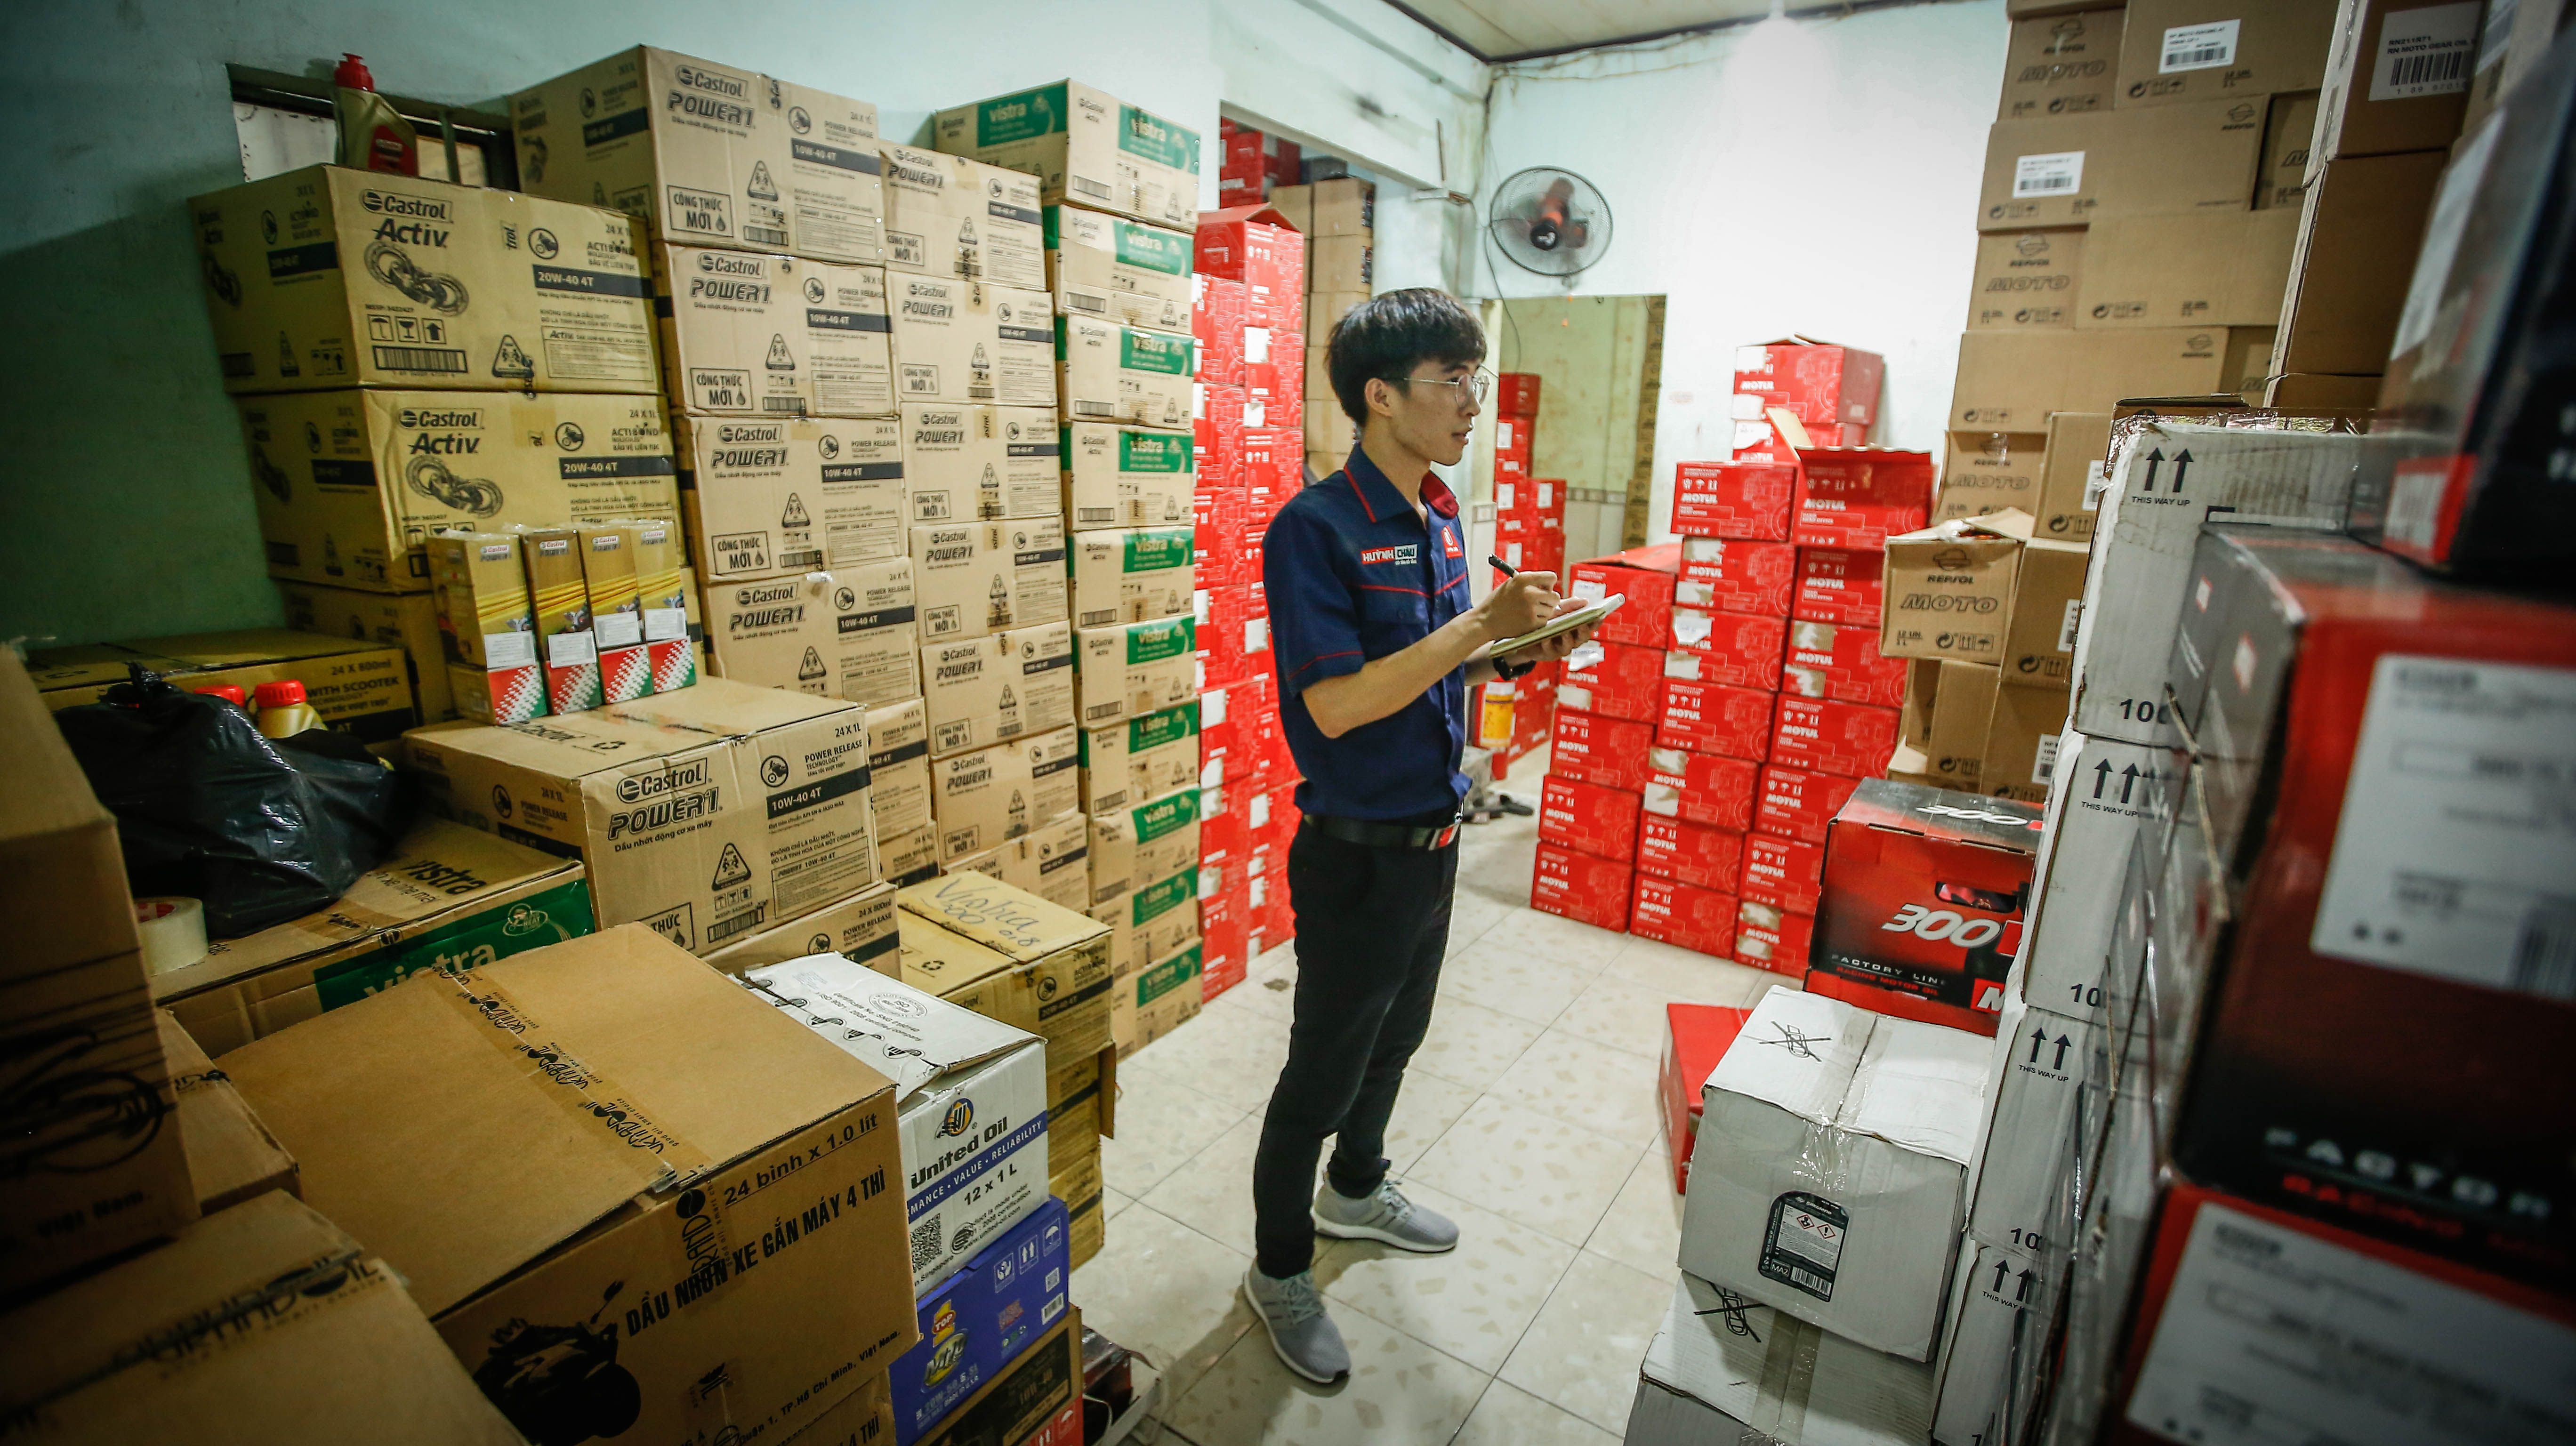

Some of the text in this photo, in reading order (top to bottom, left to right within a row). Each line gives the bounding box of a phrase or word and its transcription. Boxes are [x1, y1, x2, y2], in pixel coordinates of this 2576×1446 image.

[695, 72, 742, 96] Castrol
[667, 89, 755, 128] POWER1
[990, 103, 1026, 121] vistra
[385, 195, 446, 219] Castrol
[372, 218, 449, 247] Activ
[1127, 233, 1163, 251] vistra
[715, 257, 760, 276] Castrol
[538, 272, 594, 286] 20W-40 4T
[1985, 274, 2070, 293] MOTO
[691, 277, 771, 304] POWER1
[918, 285, 947, 298] Castrol
[903, 300, 953, 319] POWER1
[1133, 336, 1167, 352] vistra
[697, 374, 742, 387] CÔNG THỨC
[708, 387, 732, 406] MỚI
[420, 410, 476, 427] Castrol
[930, 414, 958, 425] Castrol
[735, 427, 777, 441] Castrol
[915, 430, 964, 443] POWER1
[410, 433, 480, 454] Activ
[1131, 438, 1163, 453] vistra
[711, 447, 789, 468] POWER1
[565, 463, 618, 473] 20W-40 4T
[1951, 475, 2029, 490] MOTO
[1681, 493, 1718, 504] MOTUL
[1803, 498, 1846, 510] MOTUL
[2132, 496, 2190, 507] THIS WAY UP
[718, 537, 760, 551] CÔNG THỨC
[941, 531, 967, 542] Castrol
[487, 546, 509, 554] Castrol
[1135, 538, 1167, 553] vistra
[730, 550, 750, 569] MỚI
[926, 546, 974, 563] POWER1
[1688, 566, 1723, 578] MOTUL
[867, 585, 910, 597] POWER RELEASE
[1806, 578, 1845, 589] MOTUL
[752, 586, 793, 602] Castrol
[1900, 594, 1997, 613] MOTO
[729, 604, 805, 632] POWER1
[841, 615, 878, 628] 10W-40 4T
[1139, 629, 1170, 644] vistra
[949, 648, 976, 659] Castrol
[1795, 652, 1833, 665] MOTUL
[331, 666, 344, 675] 24
[348, 665, 356, 673] X
[937, 660, 982, 680] POWER1
[342, 676, 400, 692] SCOOTEK
[1667, 708, 1701, 721] MOTUL
[835, 723, 861, 738] 24 X 1L
[1782, 725, 1819, 739] MOTUL
[805, 739, 863, 763] POWER RELEASE
[1558, 740, 1589, 753] MOTUL
[960, 755, 985, 769] Castrol
[641, 763, 701, 795] Castrol
[947, 767, 992, 790] POWER1
[1654, 774, 1686, 787] MOTUL
[772, 787, 822, 811] 10W-40 4T
[1766, 794, 1801, 808] MOTUL
[2081, 801, 2101, 810] THIS
[2103, 804, 2123, 813] WAY
[608, 786, 719, 841] POWER1
[1916, 804, 2029, 826] 300
[634, 835, 653, 848] nhớt
[654, 831, 675, 842] động
[697, 819, 713, 830] máy
[400, 860, 487, 894] vistra
[1750, 863, 1785, 877] MOTUL
[858, 909, 866, 918] 24
[867, 907, 873, 916] X
[651, 914, 681, 933] THỨC
[1882, 903, 2003, 948] 300
[1746, 928, 1780, 943] MOTUL
[1831, 954, 1947, 986] FACTORY LINE
[1836, 966, 1939, 996] RACING MOTOR OIL
[2019, 1064, 2037, 1074] THIS
[2038, 1068, 2057, 1079] WAY
[724, 1179, 750, 1205] 24
[808, 1146, 821, 1161] x
[827, 1125, 854, 1150] 1.0
[860, 1114, 877, 1133] lít
[911, 1117, 1008, 1189] United Oil
[909, 1120, 1042, 1215] MANCE VALUE RELIABILITY
[964, 1163, 1017, 1205] 12 x 1 L
[626, 1291, 670, 1336] DẦU
[733, 1242, 758, 1275] XE
[762, 1217, 799, 1258] GẮN
[803, 1196, 840, 1236] MÁY
[847, 1186, 857, 1208] 4
[861, 1165, 886, 1200] THÌ
[1772, 1264, 1789, 1277] MA2
[1983, 1291, 2019, 1309] THIS WAY
[934, 1313, 954, 1331] TOP
